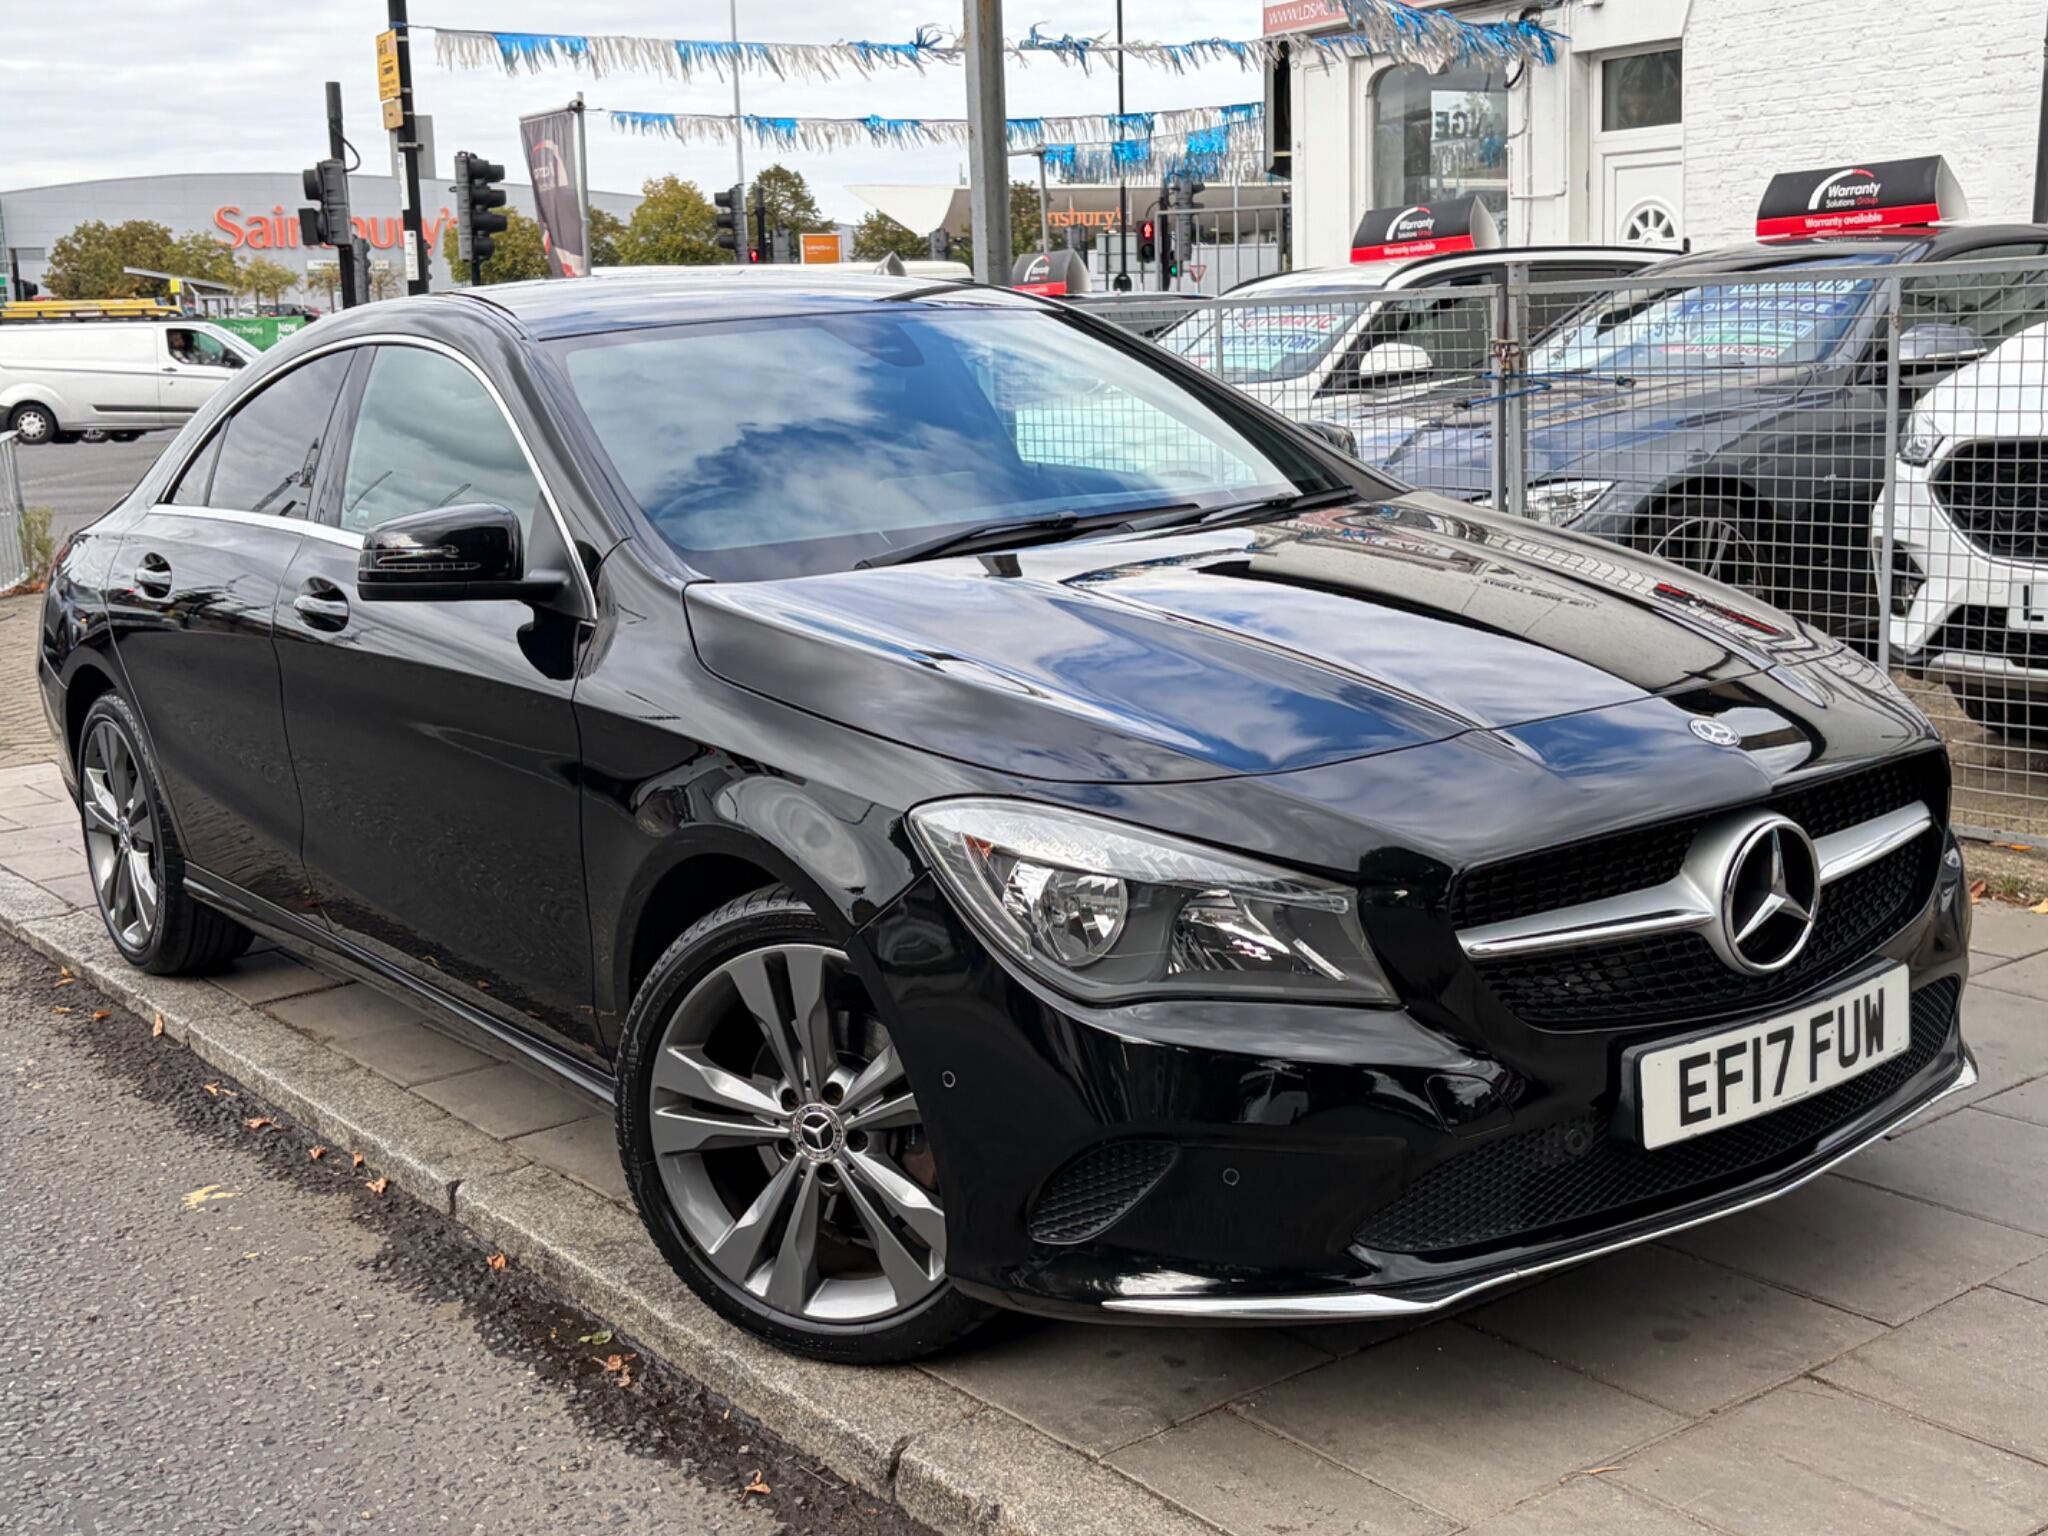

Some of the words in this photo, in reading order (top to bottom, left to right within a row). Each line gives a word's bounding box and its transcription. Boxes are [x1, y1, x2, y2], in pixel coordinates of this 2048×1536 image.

[1827, 182, 1881, 199] Warranty
[1825, 198, 1855, 209] Solutions
[1856, 196, 1879, 207] Group
[1399, 217, 1435, 231] Warranty
[1804, 217, 1843, 229] Warranty
[1843, 212, 1883, 225] available
[214, 204, 459, 257] Saiury'
[1690, 300, 1737, 314] LOW
[1739, 299, 1831, 314] MILEAGE
[1679, 1025, 1795, 1127] EF17
[1809, 986, 1885, 1083] FUW
